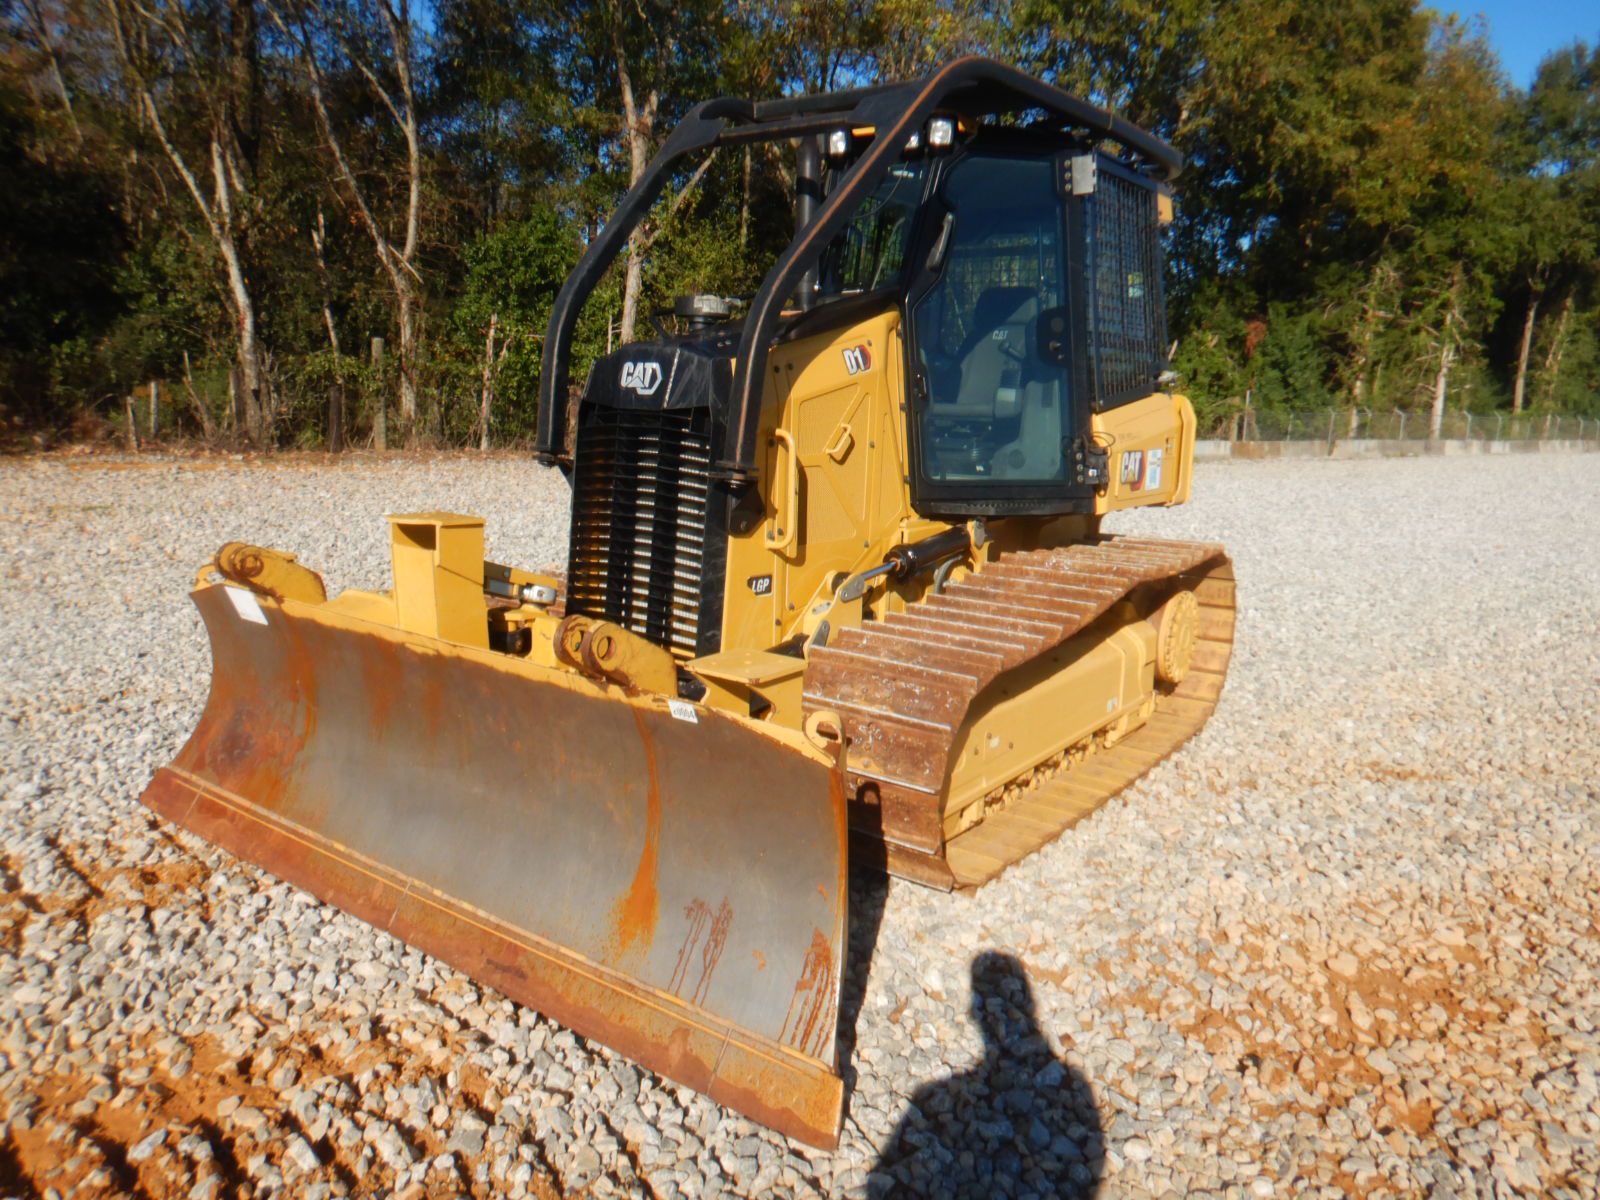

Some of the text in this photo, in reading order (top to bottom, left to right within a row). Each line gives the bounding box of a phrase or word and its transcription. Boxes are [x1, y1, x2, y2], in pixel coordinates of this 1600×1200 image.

[842, 347, 865, 375] D1
[620, 362, 660, 388] CAT
[1121, 451, 1142, 484] CAT
[752, 578, 770, 593] LGP
